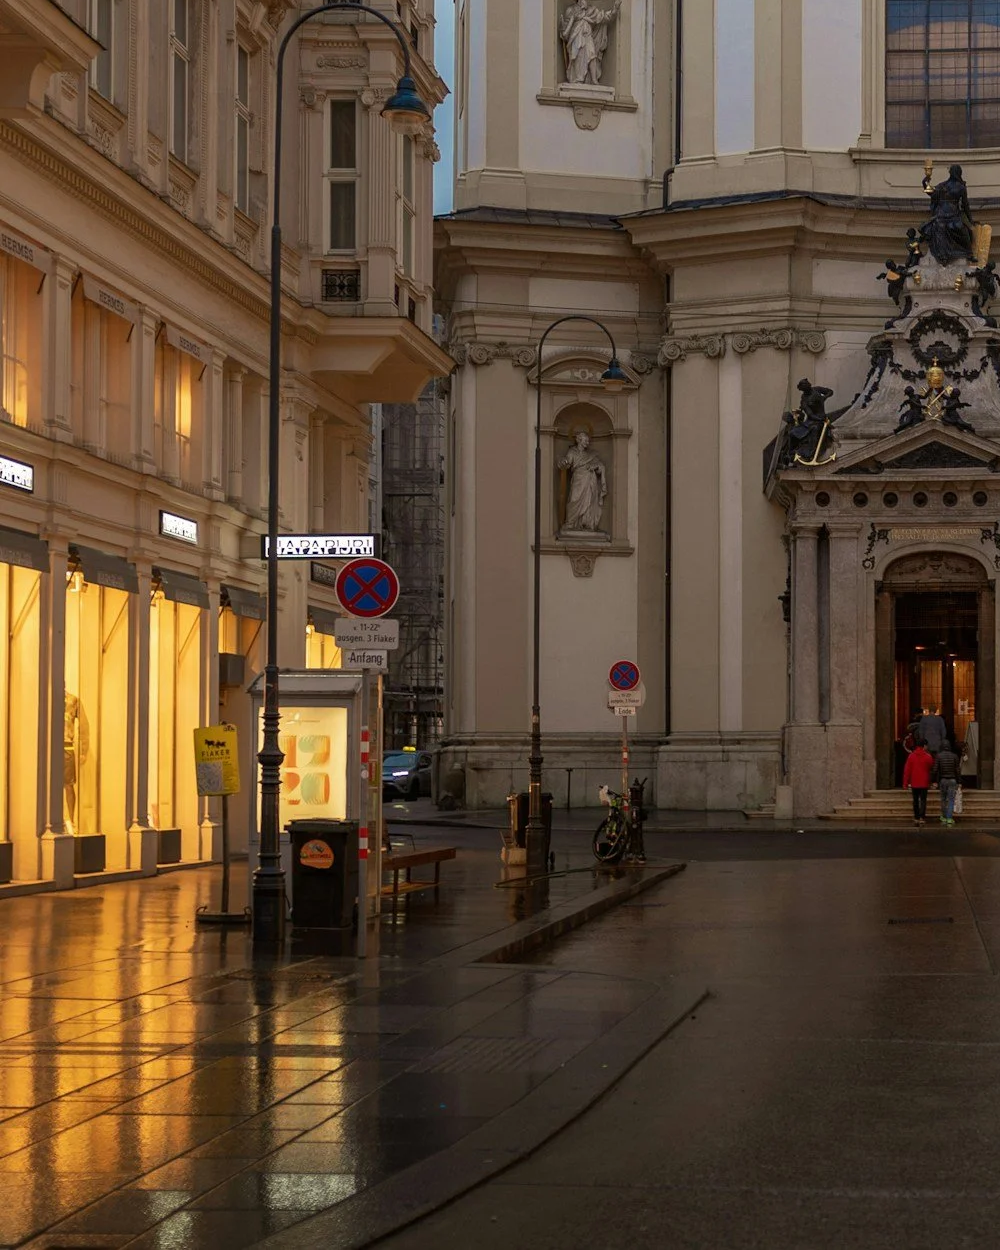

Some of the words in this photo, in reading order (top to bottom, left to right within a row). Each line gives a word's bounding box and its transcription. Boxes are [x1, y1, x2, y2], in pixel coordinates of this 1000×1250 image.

[367, 634, 373, 643] 3
[373, 634, 396, 643] Fiaker
[201, 749, 230, 758] FIAKER
